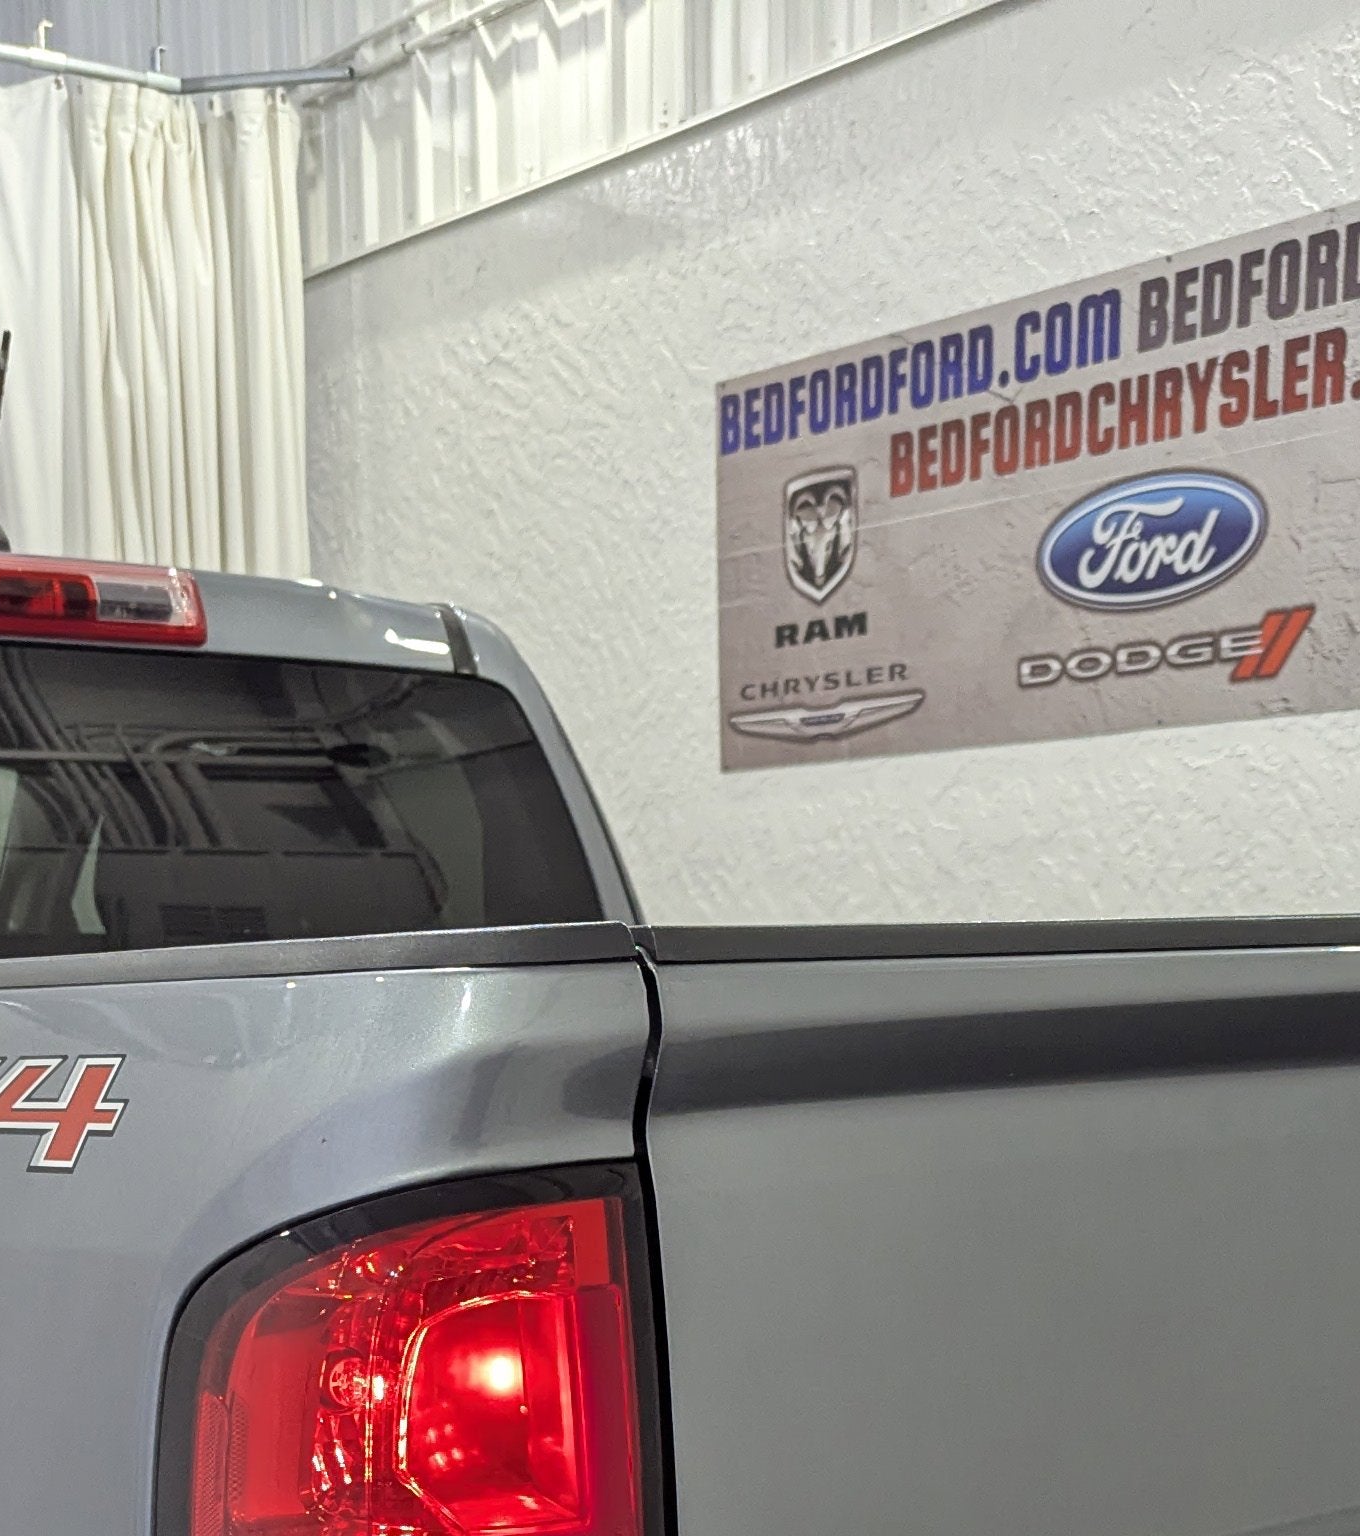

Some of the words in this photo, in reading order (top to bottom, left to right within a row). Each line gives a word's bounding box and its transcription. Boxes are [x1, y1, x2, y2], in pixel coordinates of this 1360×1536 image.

[720, 288, 1121, 456] BEDFORDFORD.COM
[1077, 497, 1217, 589] Ford
[775, 612, 868, 648] RAM
[1018, 625, 1264, 688] DODGE
[740, 663, 909, 701] CHRYSLER
